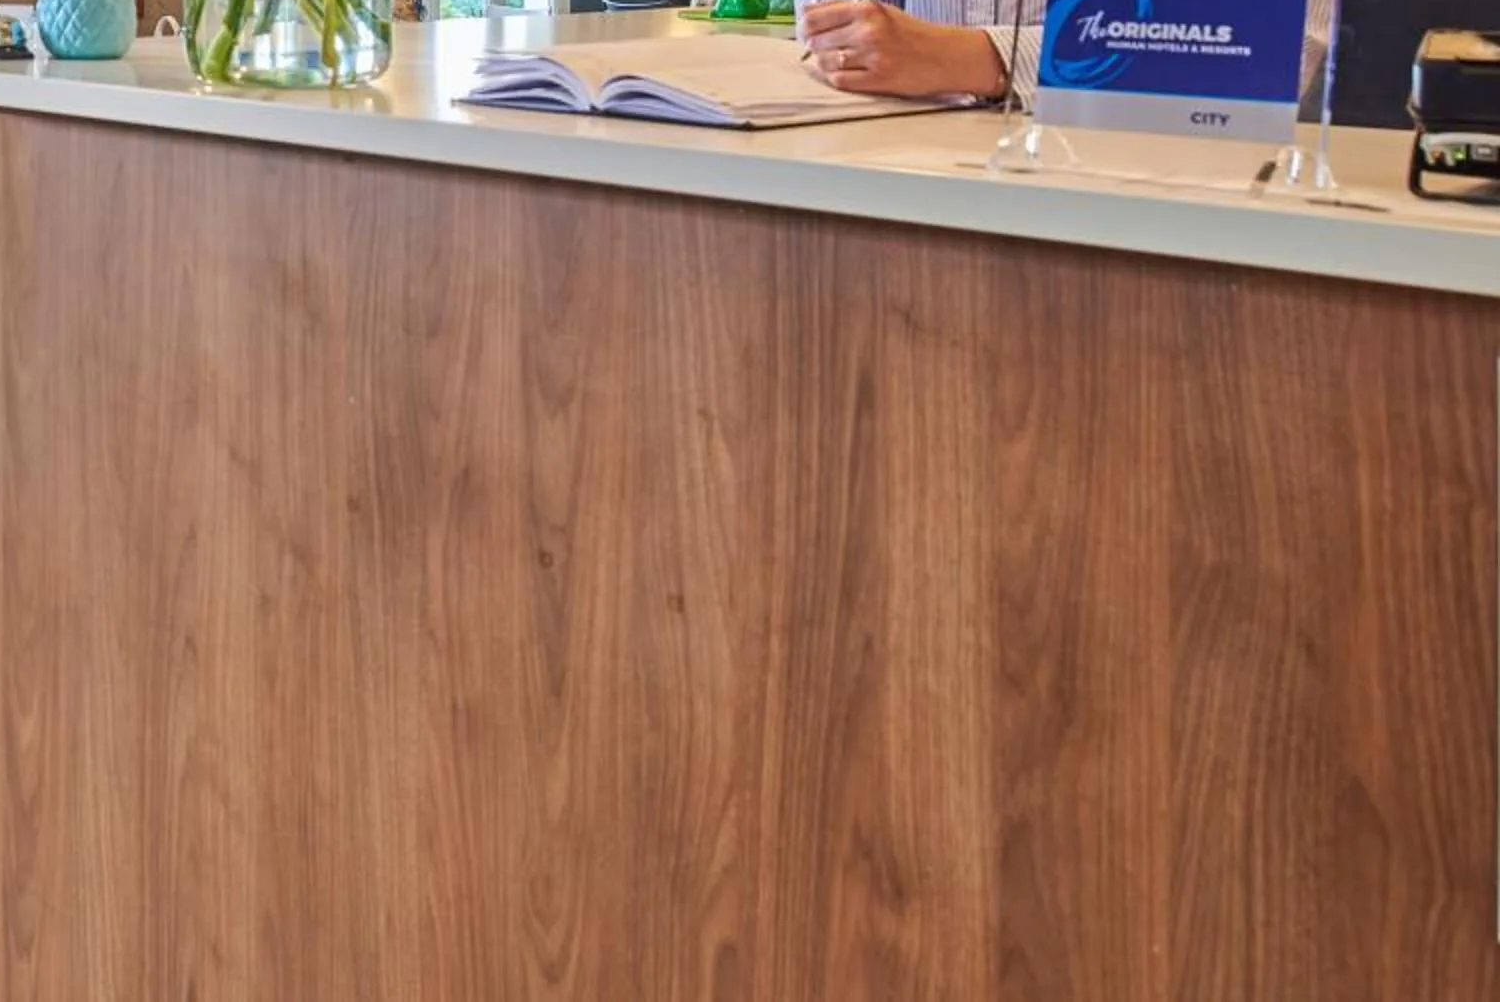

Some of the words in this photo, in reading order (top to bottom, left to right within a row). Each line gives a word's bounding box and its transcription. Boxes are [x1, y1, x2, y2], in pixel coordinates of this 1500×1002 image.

[1077, 9, 1107, 42] The
[1107, 21, 1232, 43] ORIGINALS
[1147, 42, 1189, 53] HOTELS
[1200, 45, 1252, 56] RESORTS
[1190, 112, 1231, 127] CITY
